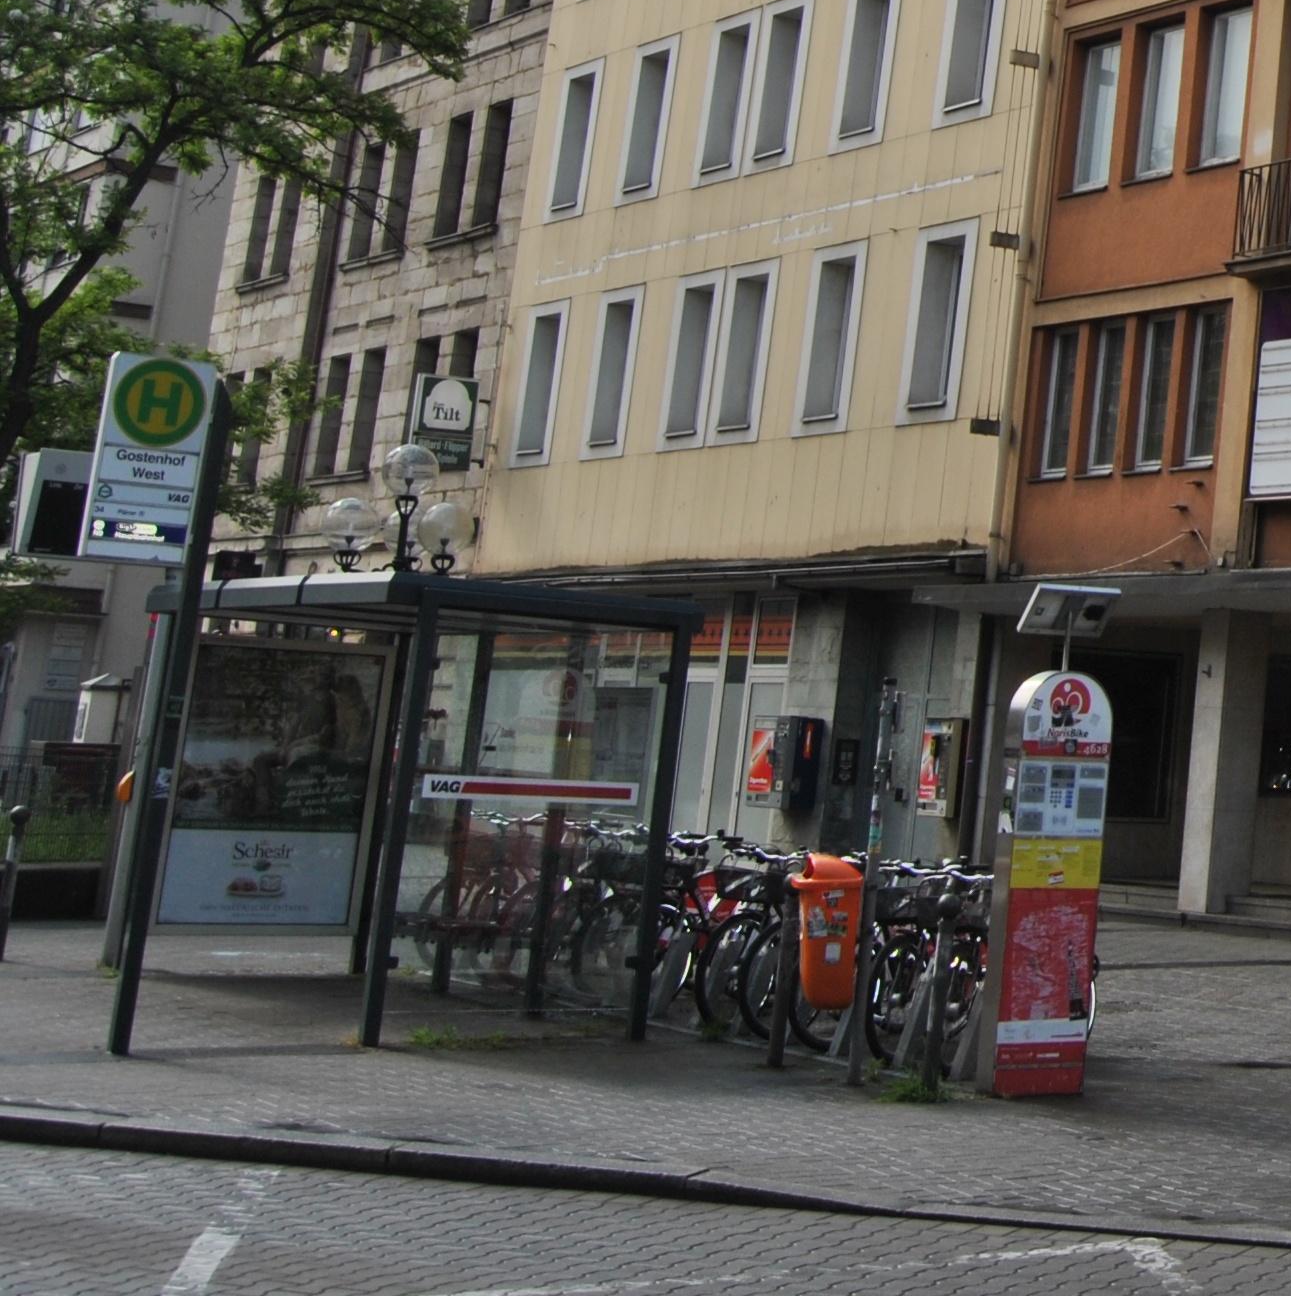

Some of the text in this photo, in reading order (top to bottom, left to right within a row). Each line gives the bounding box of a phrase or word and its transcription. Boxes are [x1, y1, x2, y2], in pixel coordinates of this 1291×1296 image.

[432, 405, 461, 421] Tilt
[116, 448, 186, 467] Gostenhof
[132, 467, 166, 481] West
[167, 493, 190, 504] VAG
[1083, 744, 1108, 754] 4628
[430, 780, 461, 793] VAG
